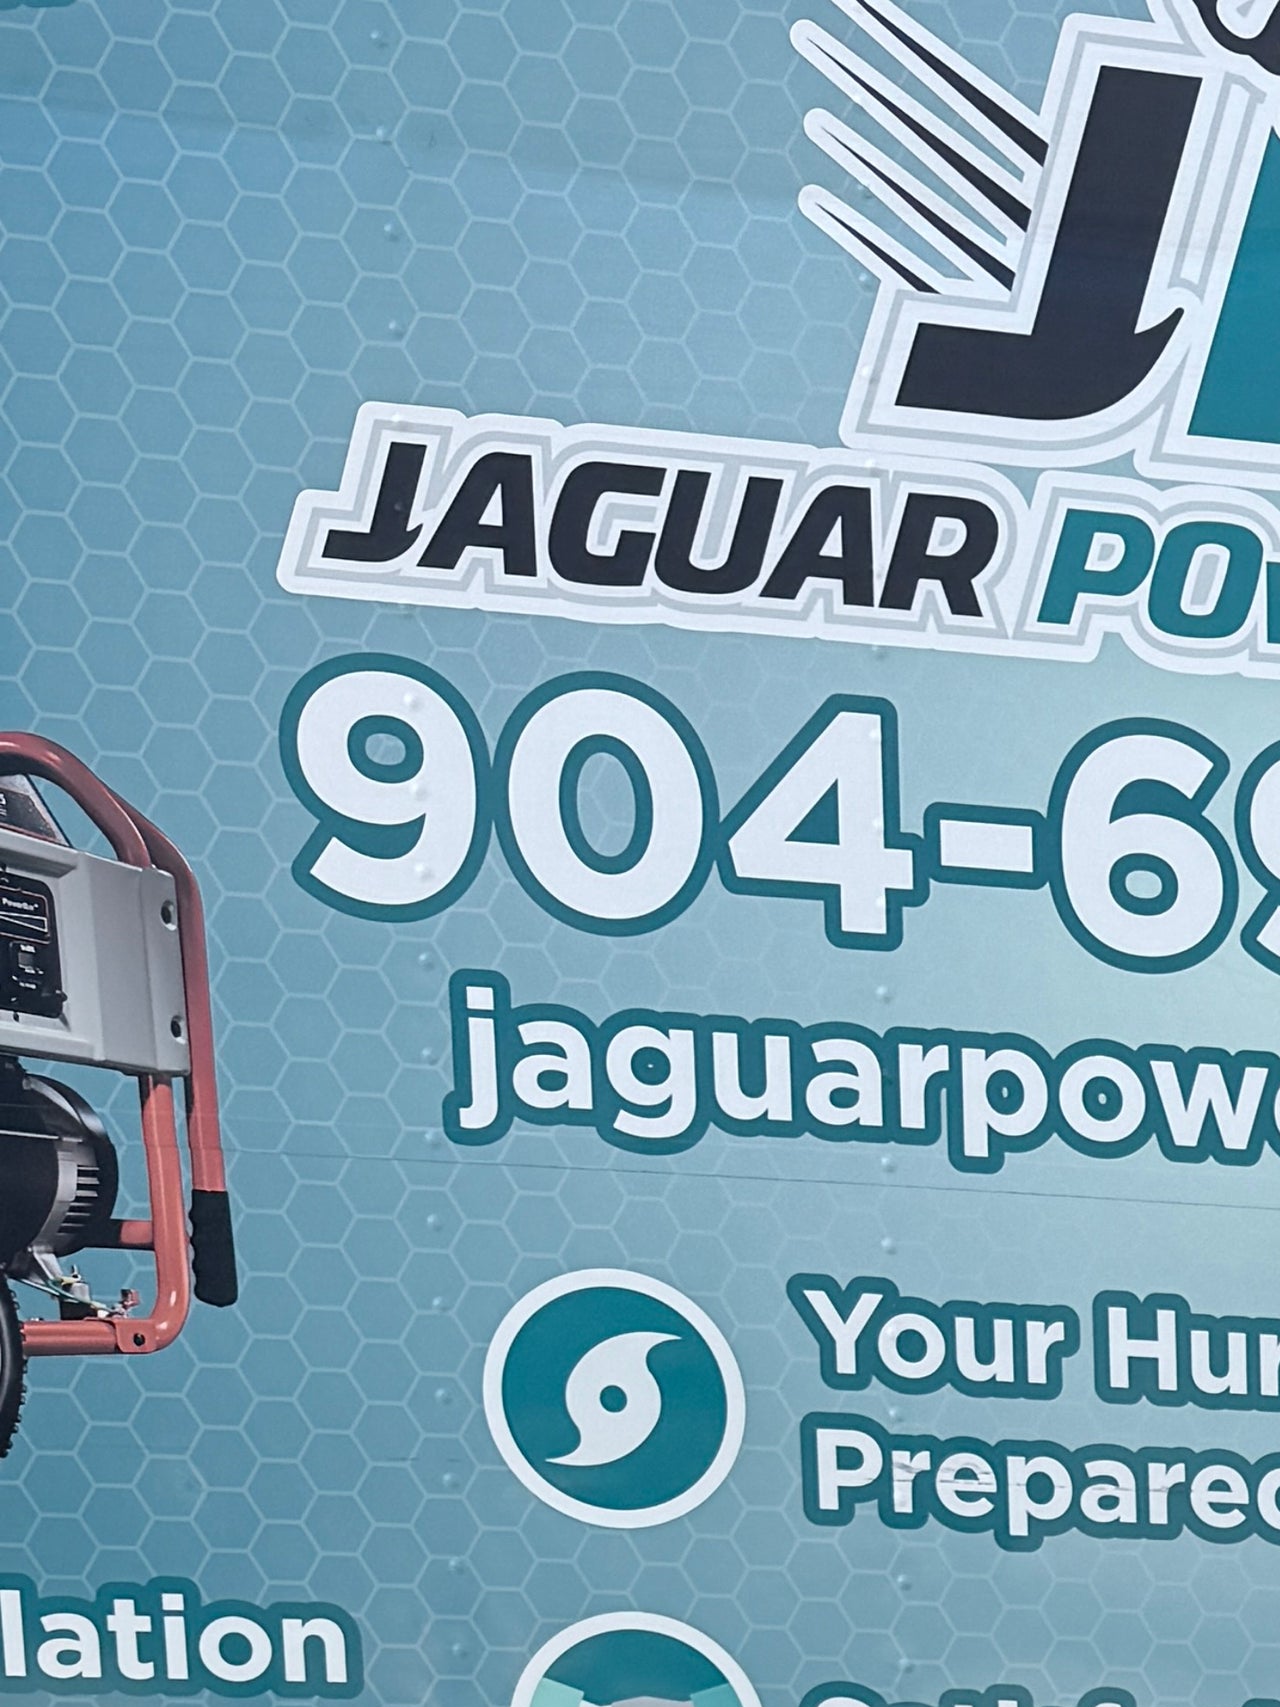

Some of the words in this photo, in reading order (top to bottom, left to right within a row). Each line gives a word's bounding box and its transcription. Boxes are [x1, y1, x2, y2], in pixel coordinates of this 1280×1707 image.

[321, 441, 999, 617] JAGUAR
[803, 1290, 1064, 1384] Your
[0, 1589, 348, 1683] lation
